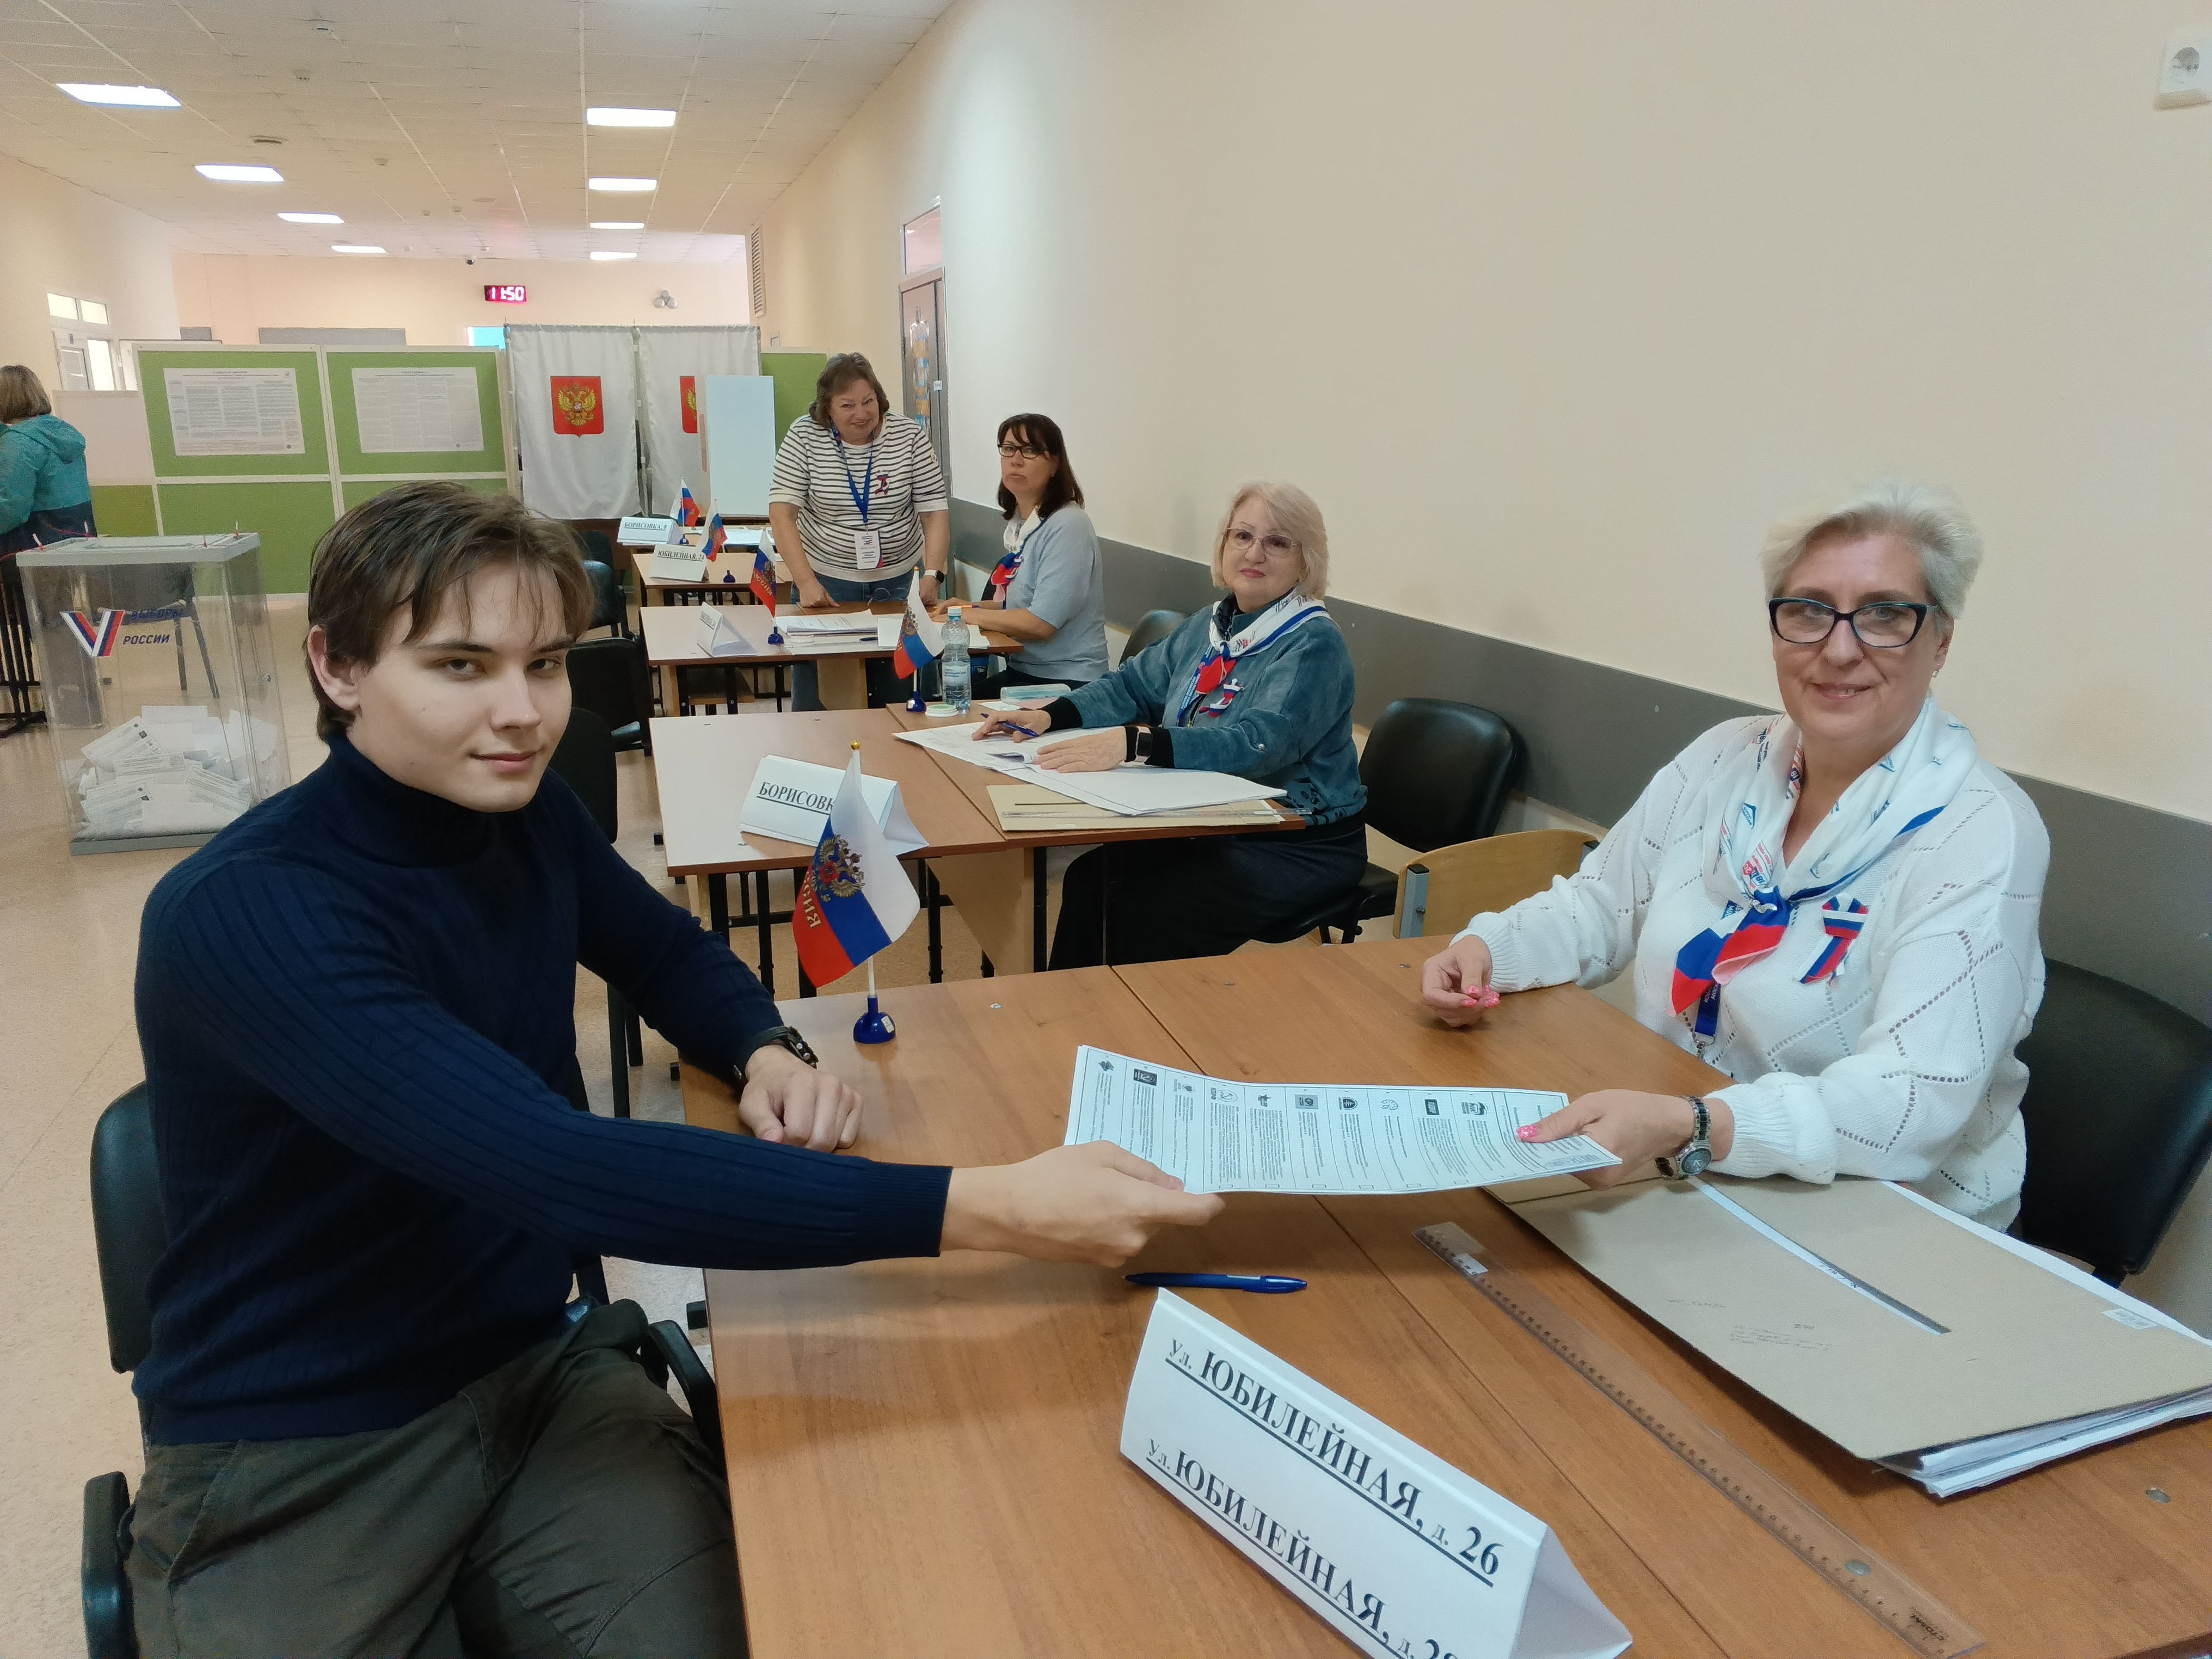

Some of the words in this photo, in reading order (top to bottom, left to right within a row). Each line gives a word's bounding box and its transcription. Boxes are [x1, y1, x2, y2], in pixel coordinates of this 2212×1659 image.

[122, 634, 170, 645] РОССИИ
[1148, 1438, 1170, 1470] Ул.
[1173, 1448, 1389, 1644] ЮБИЛЕЙНАЯ,
[1425, 1638, 1459, 1659] 2
[1169, 1337, 1192, 1370] Ул.
[1199, 1348, 1423, 1532] ЮБИЛЕЙНАЯ,
[1431, 1523, 1449, 1546] д.
[1458, 1526, 1506, 1575] 26
